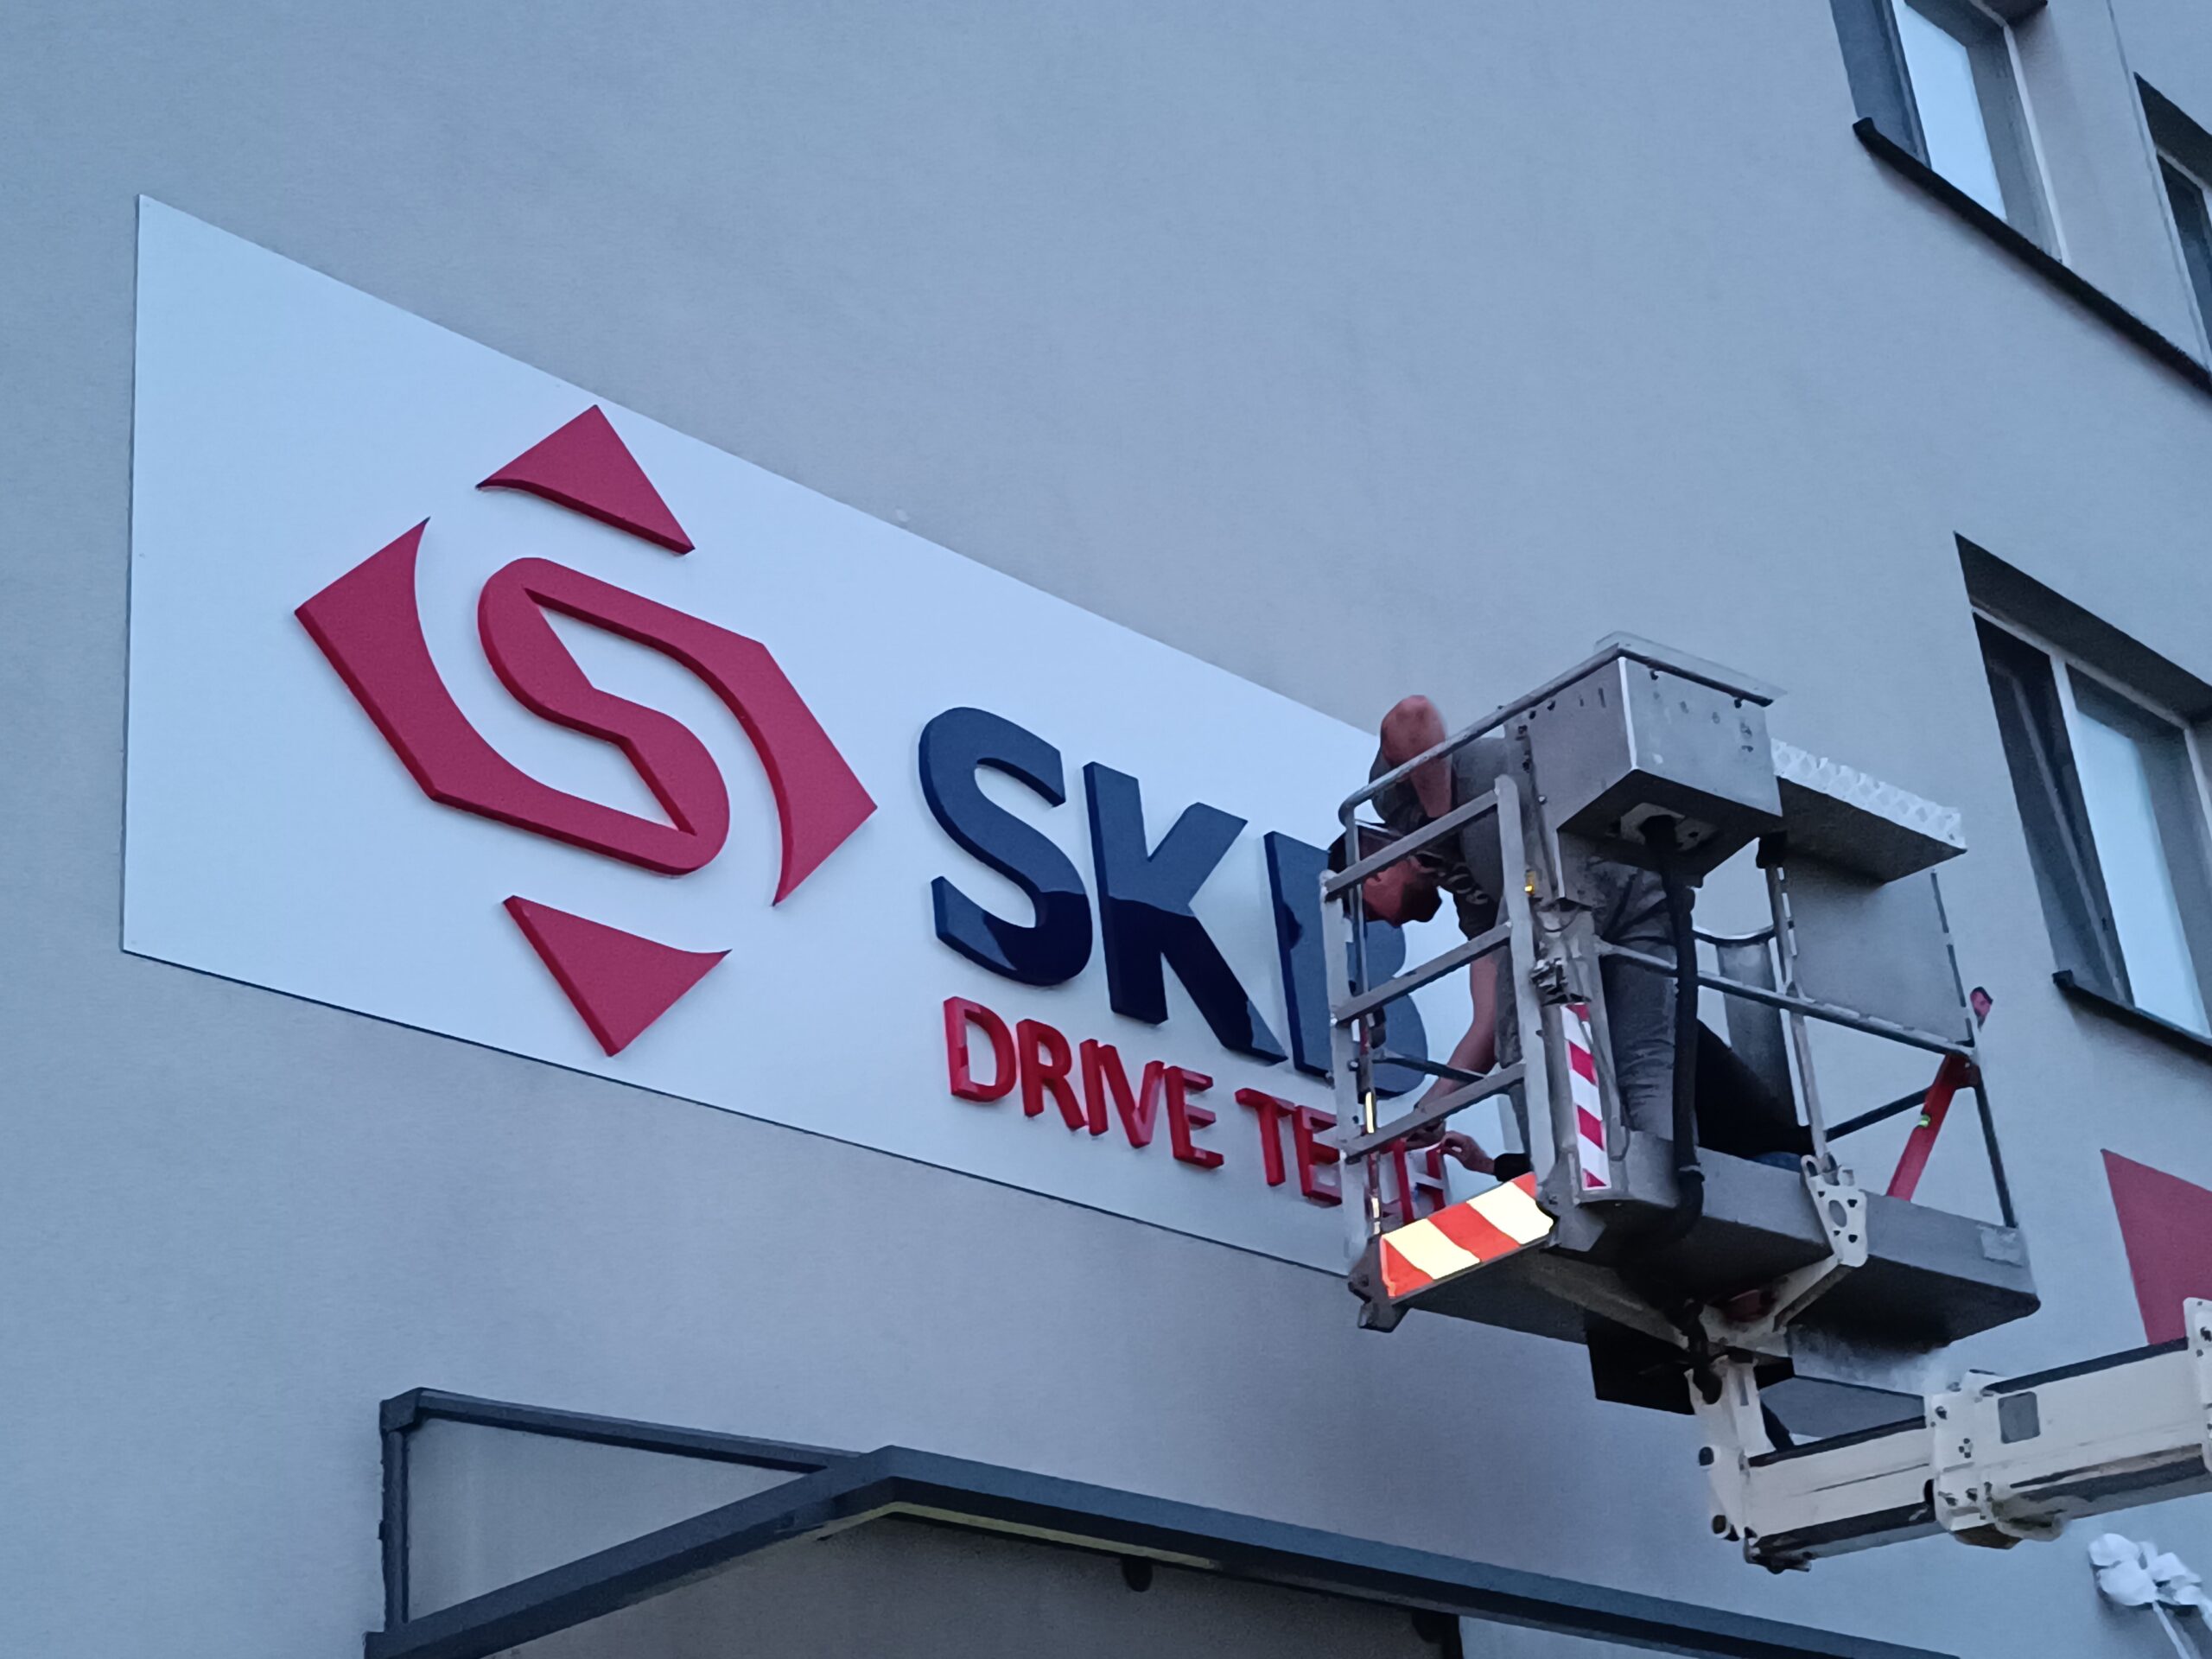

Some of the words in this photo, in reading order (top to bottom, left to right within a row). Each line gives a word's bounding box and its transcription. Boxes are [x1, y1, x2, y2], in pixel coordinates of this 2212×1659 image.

[918, 707, 1428, 1099] SKB
[943, 995, 1224, 1168] DRIVE
[1234, 1087, 1449, 1224] TEH
